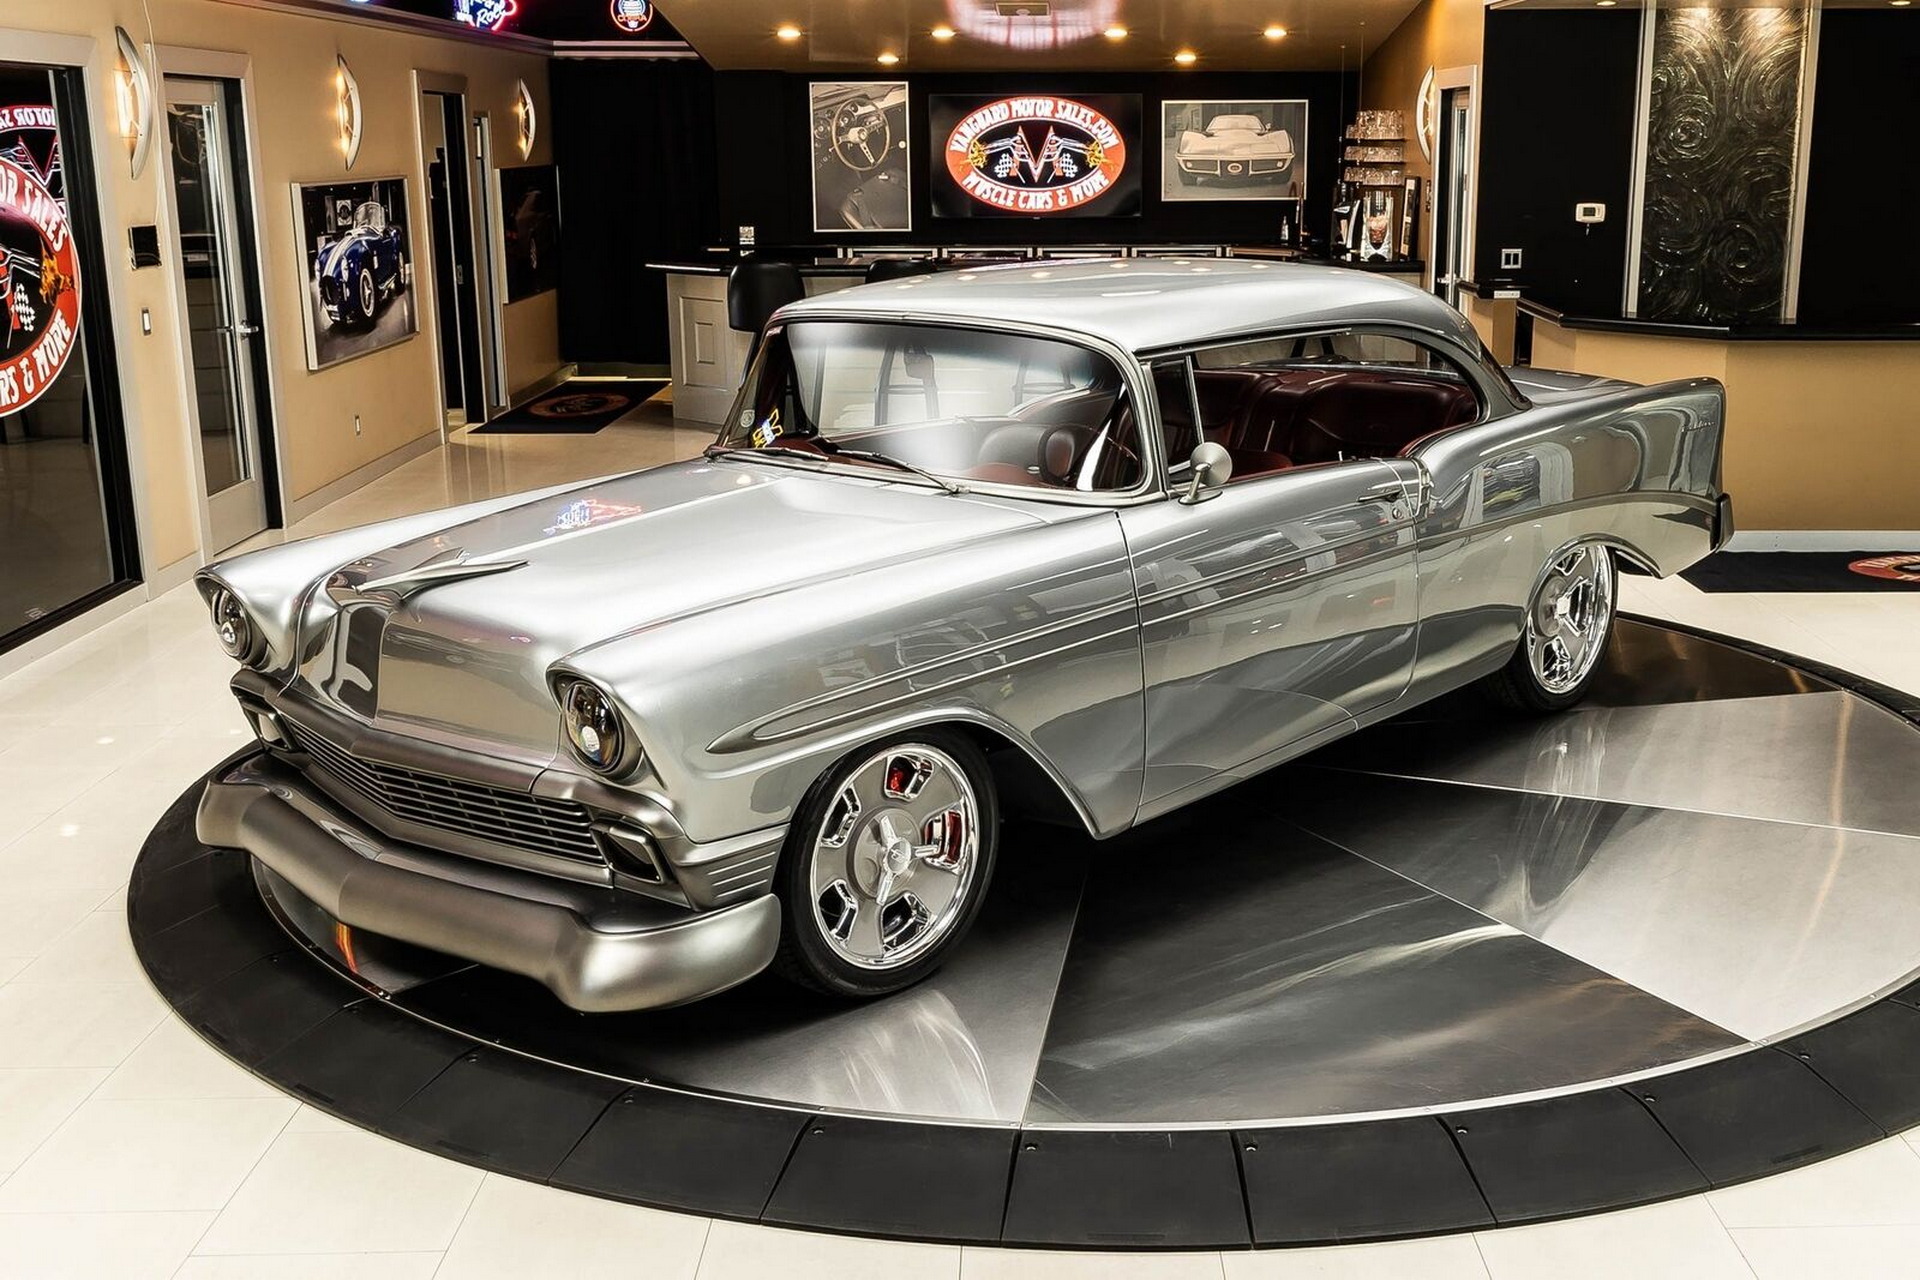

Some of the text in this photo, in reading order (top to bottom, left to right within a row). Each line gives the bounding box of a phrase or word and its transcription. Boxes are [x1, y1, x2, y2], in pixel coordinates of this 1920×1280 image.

[950, 103, 1010, 151] VANGUARD
[1010, 99, 1054, 118] MOTOR
[22, 179, 68, 252] SALES
[963, 170, 1110, 210] MUSCLE CARS & MORE
[19, 357, 35, 394] &
[32, 309, 71, 383] MORE
